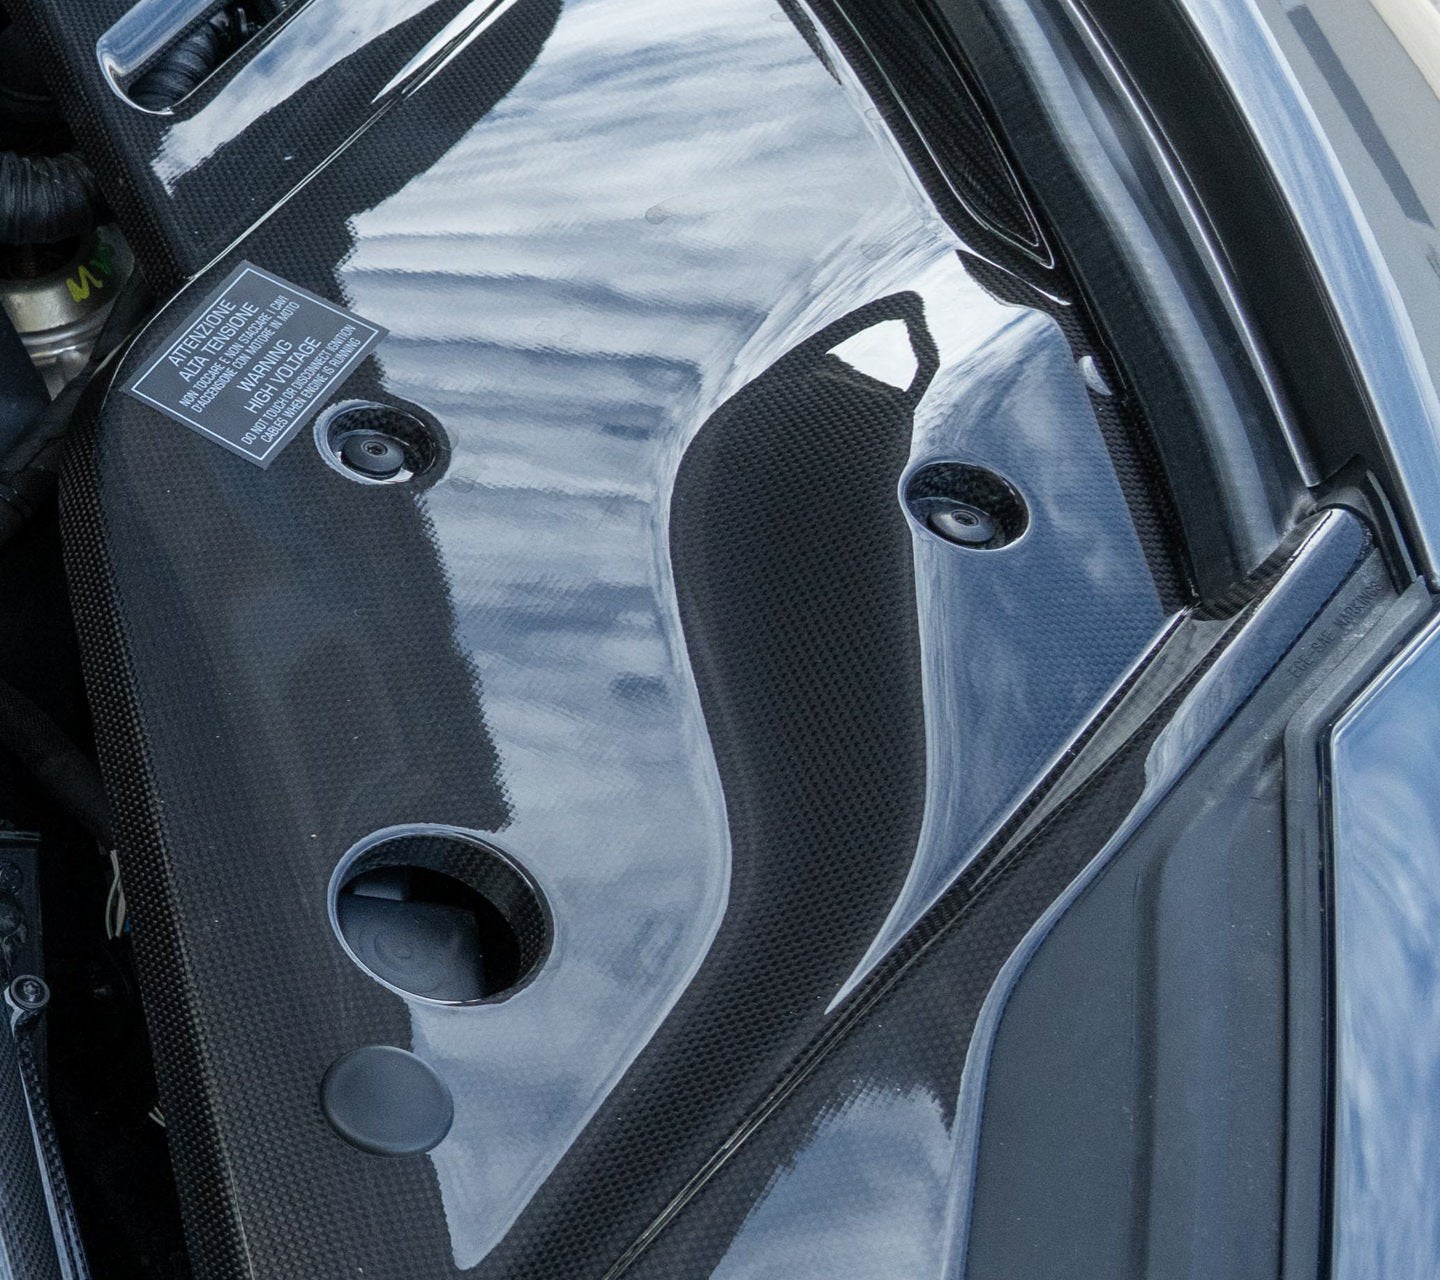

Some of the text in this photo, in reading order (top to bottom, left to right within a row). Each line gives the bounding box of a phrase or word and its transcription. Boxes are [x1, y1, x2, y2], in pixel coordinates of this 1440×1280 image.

[241, 312, 273, 345] STACCARE
[270, 295, 289, 311] CAVI
[168, 299, 236, 368] ATTENZIONE
[179, 301, 259, 383] ALTA TENSIONE
[191, 301, 300, 414] D'ACCENSIONE CON MOTORE IN MOTO
[224, 356, 231, 365] E
[227, 342, 242, 359] NON
[194, 362, 225, 393] TOCCARE
[236, 339, 293, 393] WARNING
[241, 324, 357, 445] DO NOT TOUCH OR DISCONNECT IGNITION
[244, 336, 322, 414] HIGH VOLTAGE
[261, 338, 361, 443] CABLES WHEN ENGINE IS RUNNING
[179, 390, 196, 408] NON
